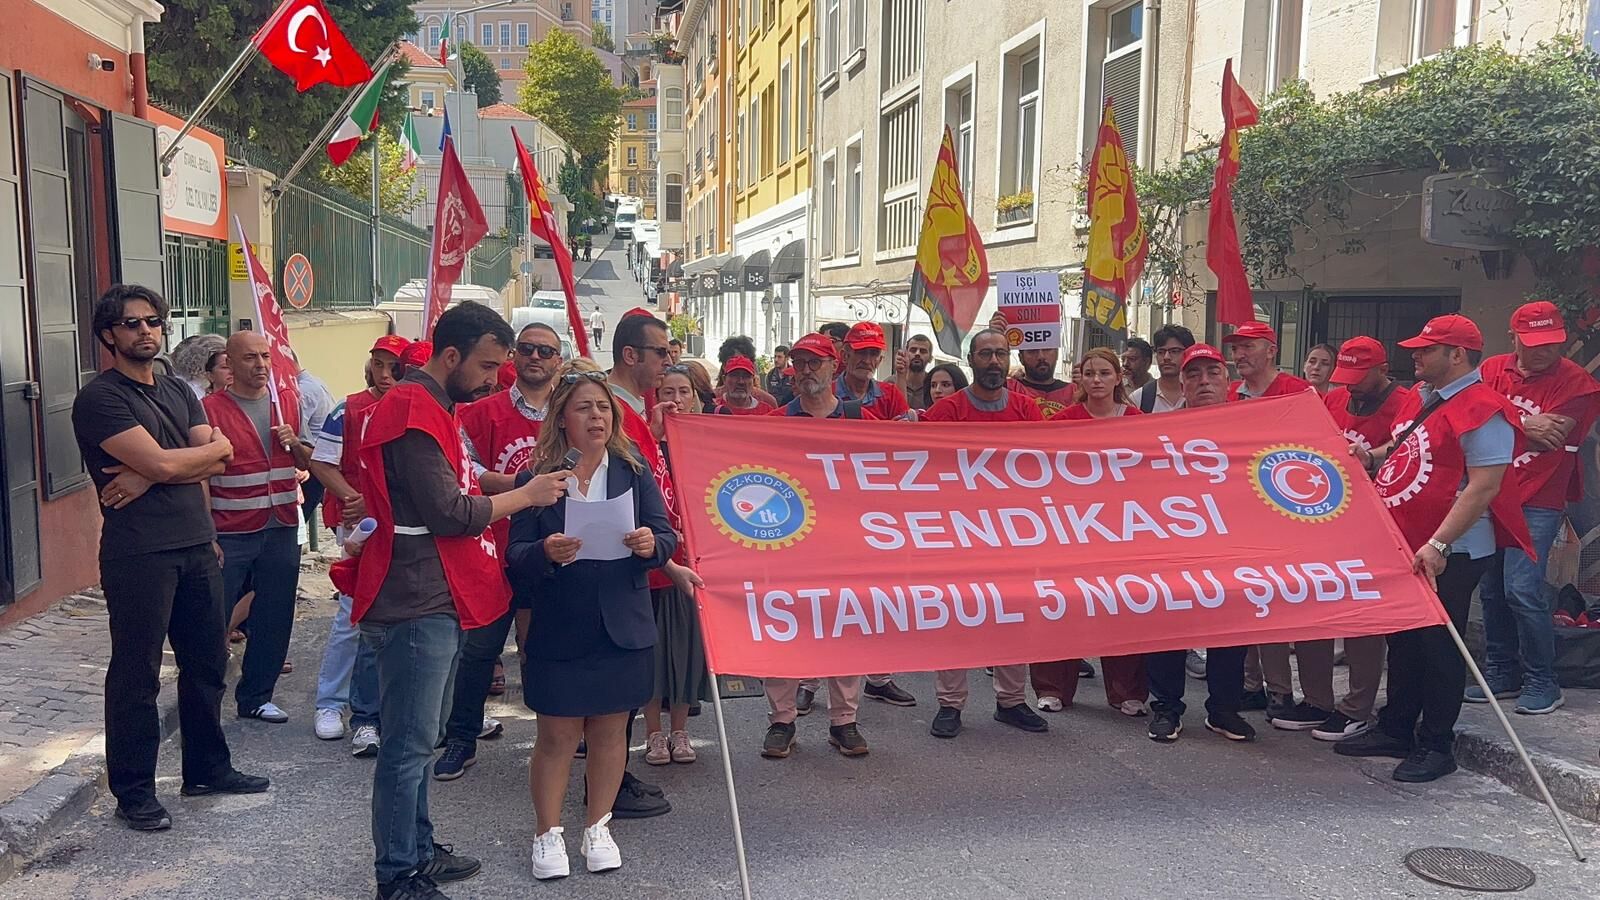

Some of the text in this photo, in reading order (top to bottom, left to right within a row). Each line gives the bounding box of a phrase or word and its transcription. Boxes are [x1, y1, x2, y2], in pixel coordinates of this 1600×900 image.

[1016, 275, 1037, 290] İŞÇİ
[1003, 291, 1054, 304] KIYIMINA
[1024, 330, 1052, 343] SEP
[806, 434, 1230, 491] TEZ-KOOP-İŞ
[721, 474, 795, 499] TEZ-KOOP-İŞ
[1295, 501, 1333, 515] 1952
[860, 492, 1229, 550] SENDİKASI
[753, 528, 783, 538] 1962
[744, 557, 1382, 643] İSTANBUL 5 NOLU ŞUBE
